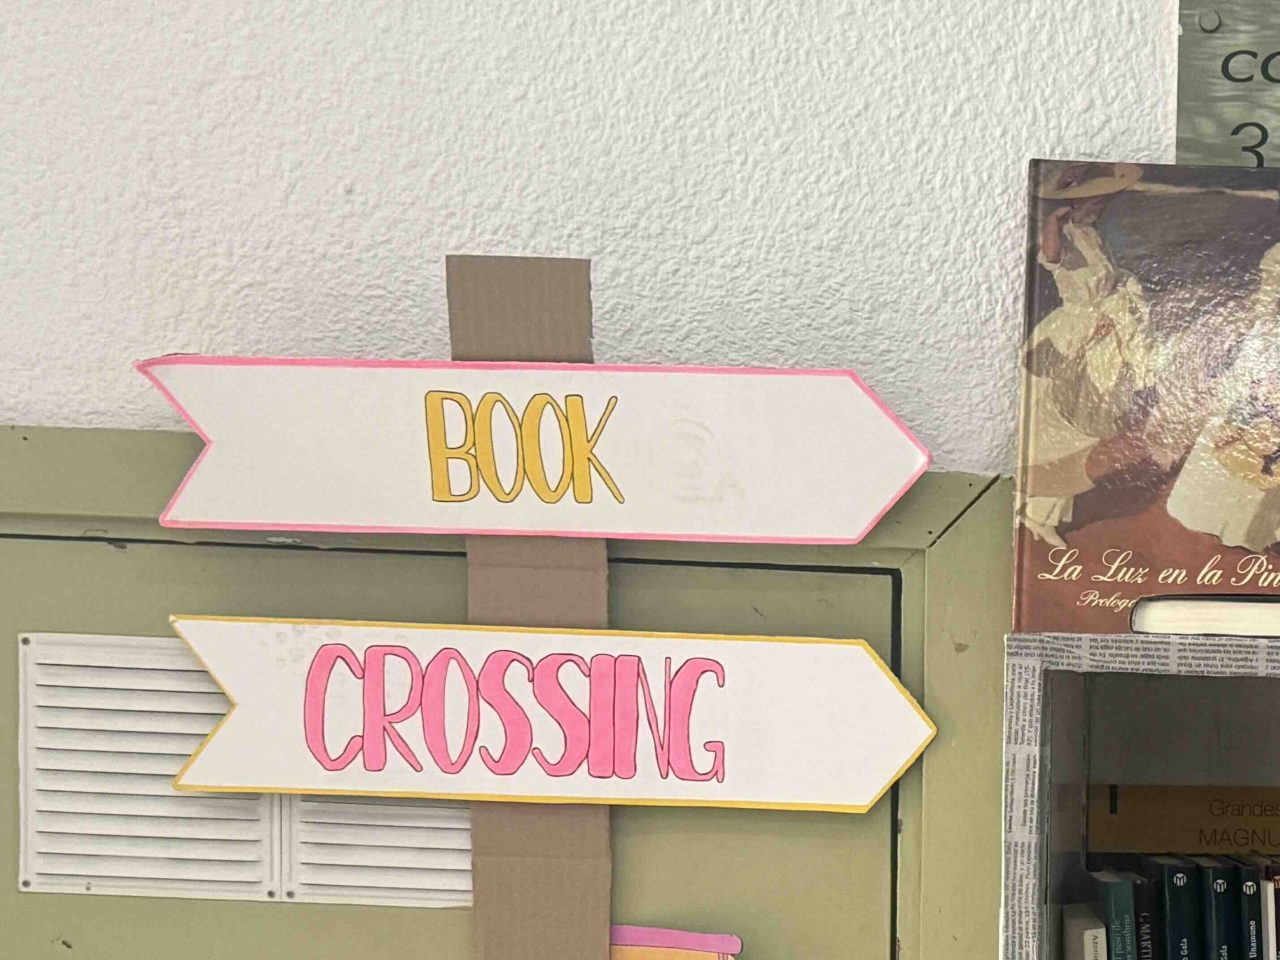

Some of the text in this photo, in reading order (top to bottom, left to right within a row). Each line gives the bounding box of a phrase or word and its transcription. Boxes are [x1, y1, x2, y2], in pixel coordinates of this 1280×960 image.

[424, 389, 626, 505] BOOK
[1037, 546, 1083, 582] La
[1091, 548, 1151, 585] Luz
[1157, 566, 1189, 585] en
[1196, 553, 1223, 586] la
[302, 642, 726, 785] CROSSING
[1180, 937, 1188, 952] Gala
[1219, 944, 1228, 958] Gala
[1249, 920, 1257, 957] Unamuno
